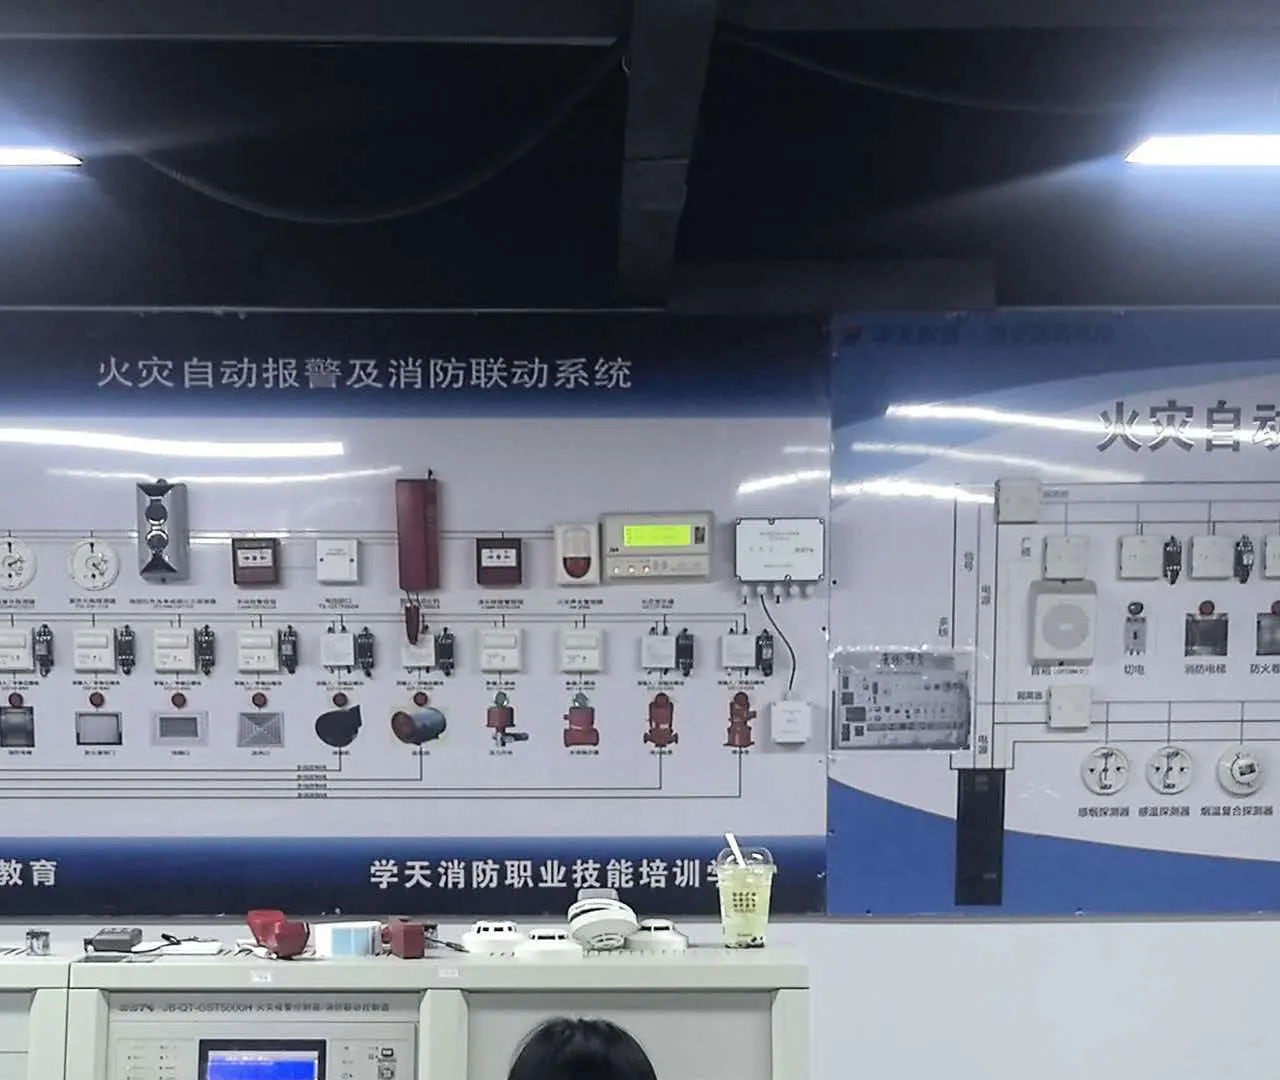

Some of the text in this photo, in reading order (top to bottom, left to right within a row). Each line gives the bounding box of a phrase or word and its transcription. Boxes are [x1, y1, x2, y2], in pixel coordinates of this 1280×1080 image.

[97, 355, 633, 391] 火灾自动报警及消防联动系统
